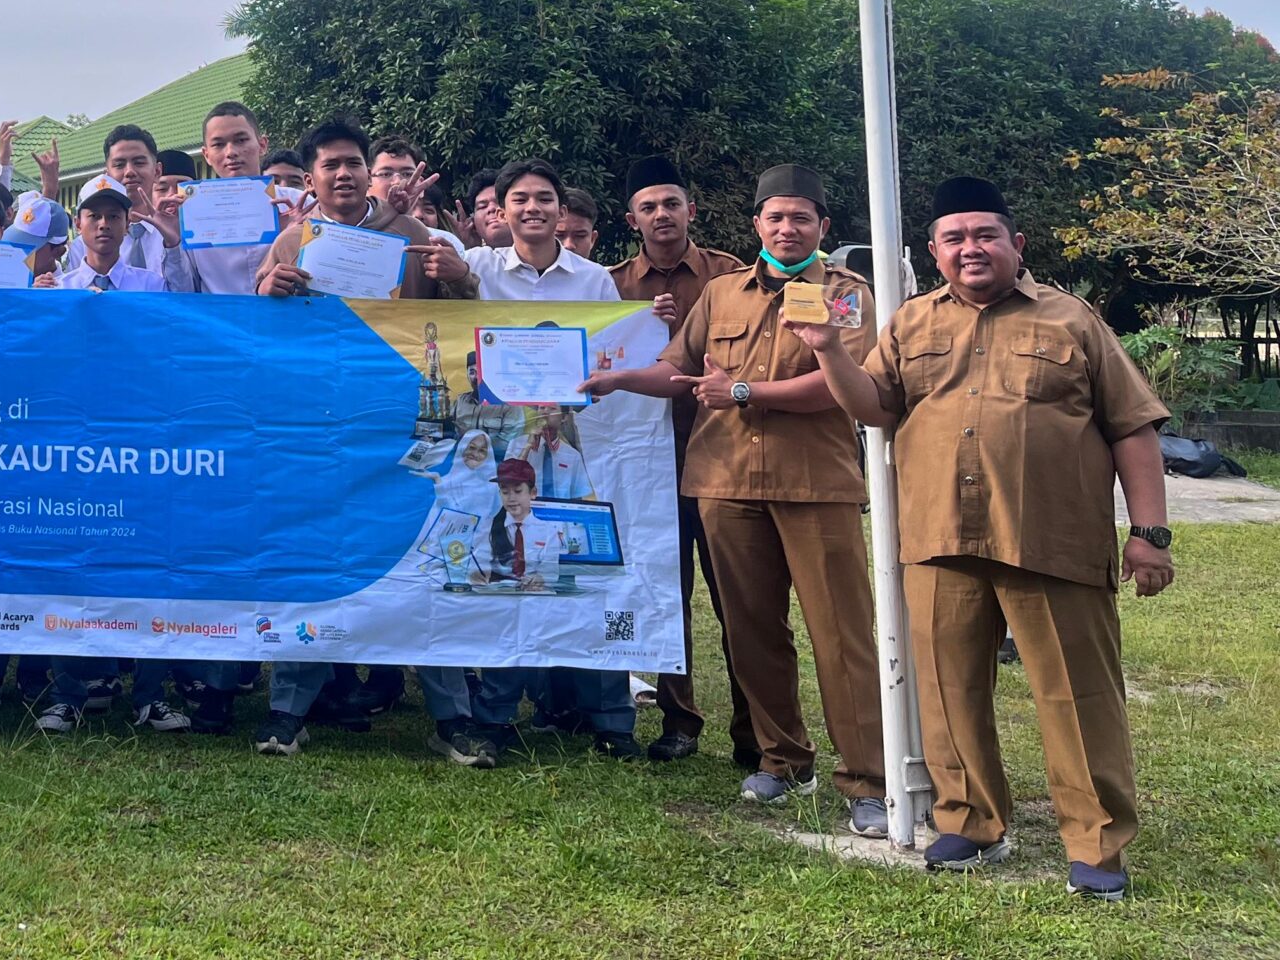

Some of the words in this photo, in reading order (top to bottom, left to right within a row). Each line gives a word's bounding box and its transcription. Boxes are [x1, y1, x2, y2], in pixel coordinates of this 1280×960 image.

[8, 398, 29, 419] di
[150, 448, 225, 477] DURI
[38, 497, 124, 518] Nasional
[8, 524, 32, 534] Buku
[34, 525, 77, 535] Nasional
[80, 526, 109, 536] Tahun
[111, 527, 136, 537] 2024
[3, 613, 34, 625] Acarya
[59, 617, 138, 632] Nyalaakademi
[167, 622, 238, 638] Nyalagaleri
